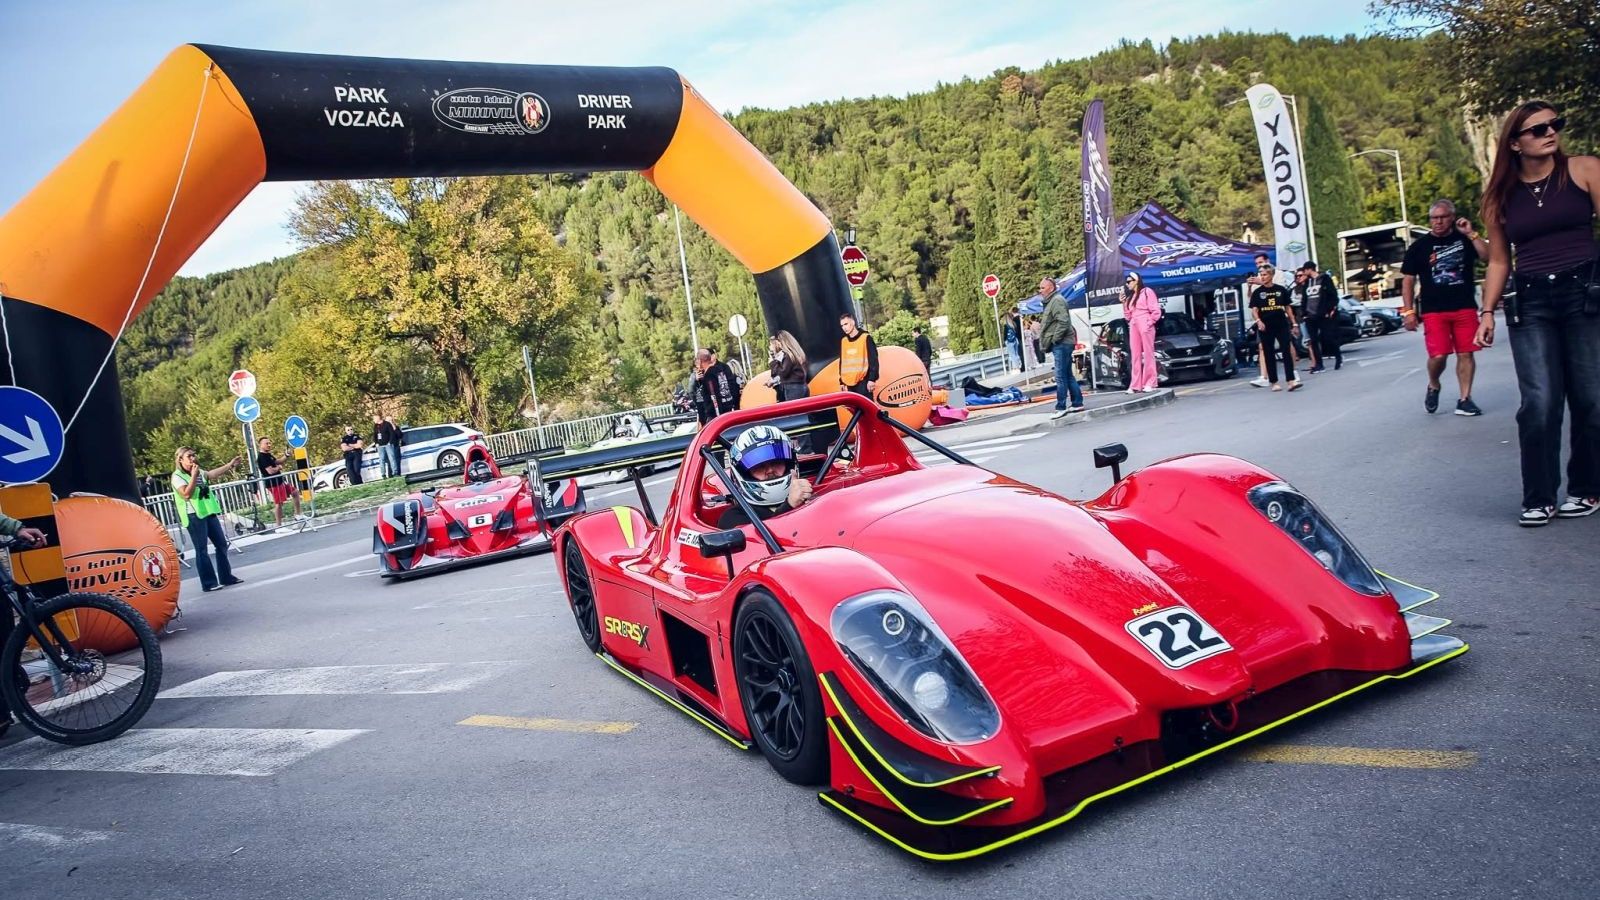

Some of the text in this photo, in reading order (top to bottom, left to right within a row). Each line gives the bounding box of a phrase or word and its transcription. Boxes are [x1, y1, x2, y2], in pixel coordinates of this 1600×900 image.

[334, 86, 389, 103] PARK
[577, 94, 633, 109] DRIVER
[324, 107, 404, 127] VOZAČA
[448, 106, 515, 119] MIHOVIL
[588, 114, 626, 129] PARK
[1161, 261, 1237, 278] TOKIĆ RACING TEAM
[475, 516, 485, 525] 6
[88, 557, 127, 570] klub
[68, 569, 132, 590] HOVIL
[1138, 612, 1225, 662] 22
